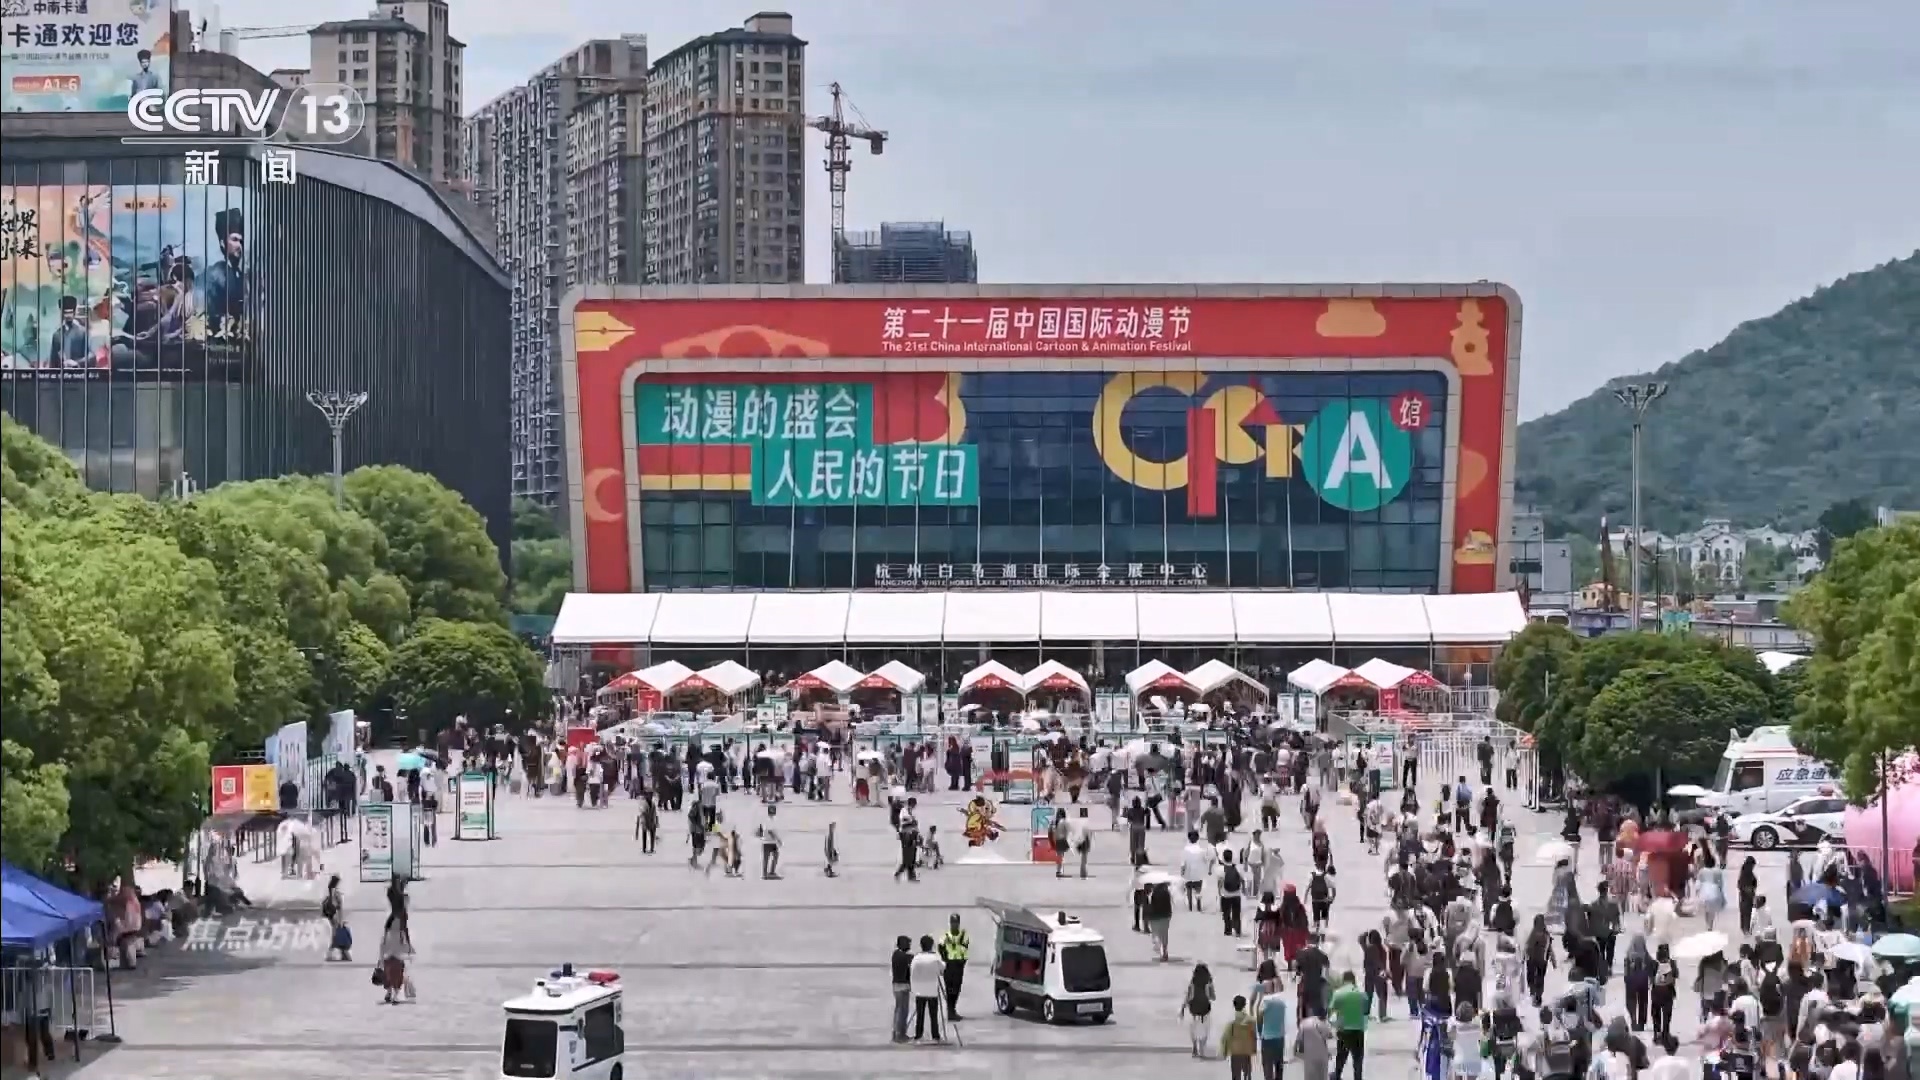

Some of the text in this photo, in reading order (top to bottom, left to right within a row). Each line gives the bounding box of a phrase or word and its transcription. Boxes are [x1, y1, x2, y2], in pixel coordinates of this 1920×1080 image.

[33, 0, 88, 15] 中南卡通
[1, 22, 139, 47] 卡通欢迎您
[882, 306, 1192, 339] 第二十一届中国国际动漫节
[882, 340, 1192, 352] The 21st China International Cartoon & Animation Festival
[660, 387, 861, 441] 动漫的盛会
[1400, 397, 1422, 428] 馆
[1323, 411, 1393, 489] A
[766, 449, 966, 500] 人民的节日
